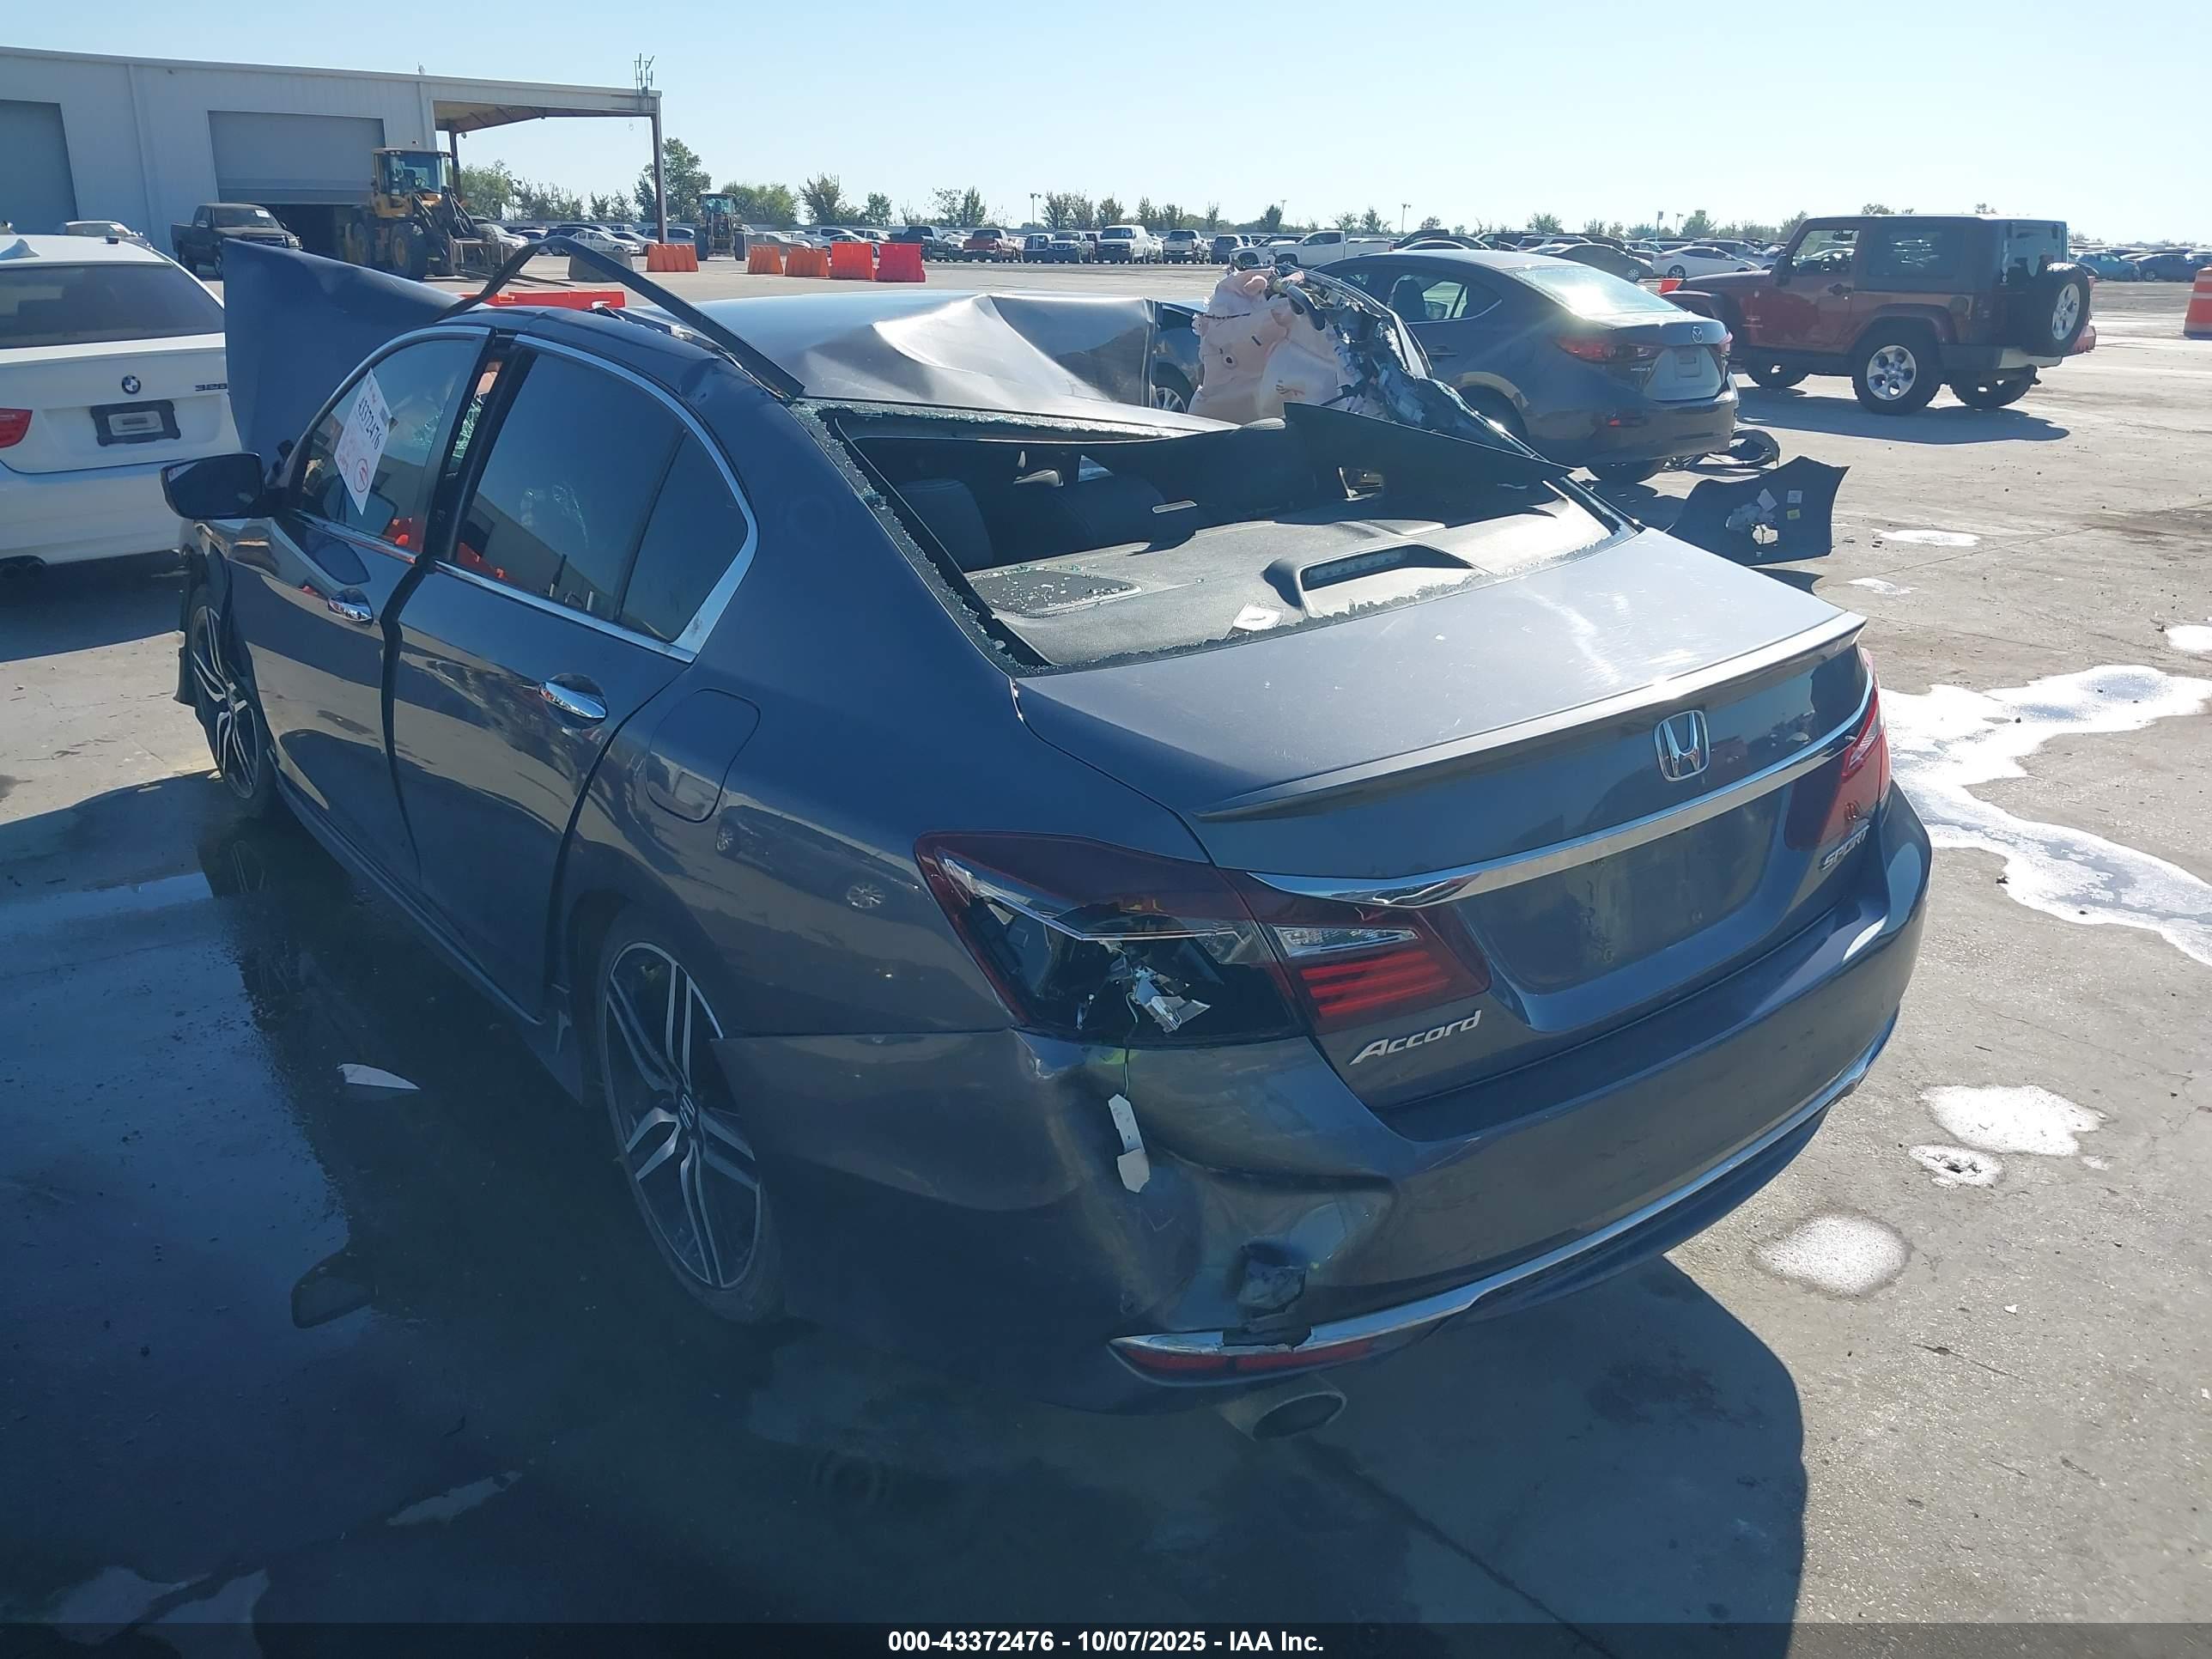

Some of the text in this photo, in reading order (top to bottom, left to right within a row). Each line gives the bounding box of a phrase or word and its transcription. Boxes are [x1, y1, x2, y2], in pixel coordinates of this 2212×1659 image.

[357, 397, 383, 450] 43372476
[1821, 824, 1870, 871] SPORT
[1349, 1009, 1482, 1066] Accord
